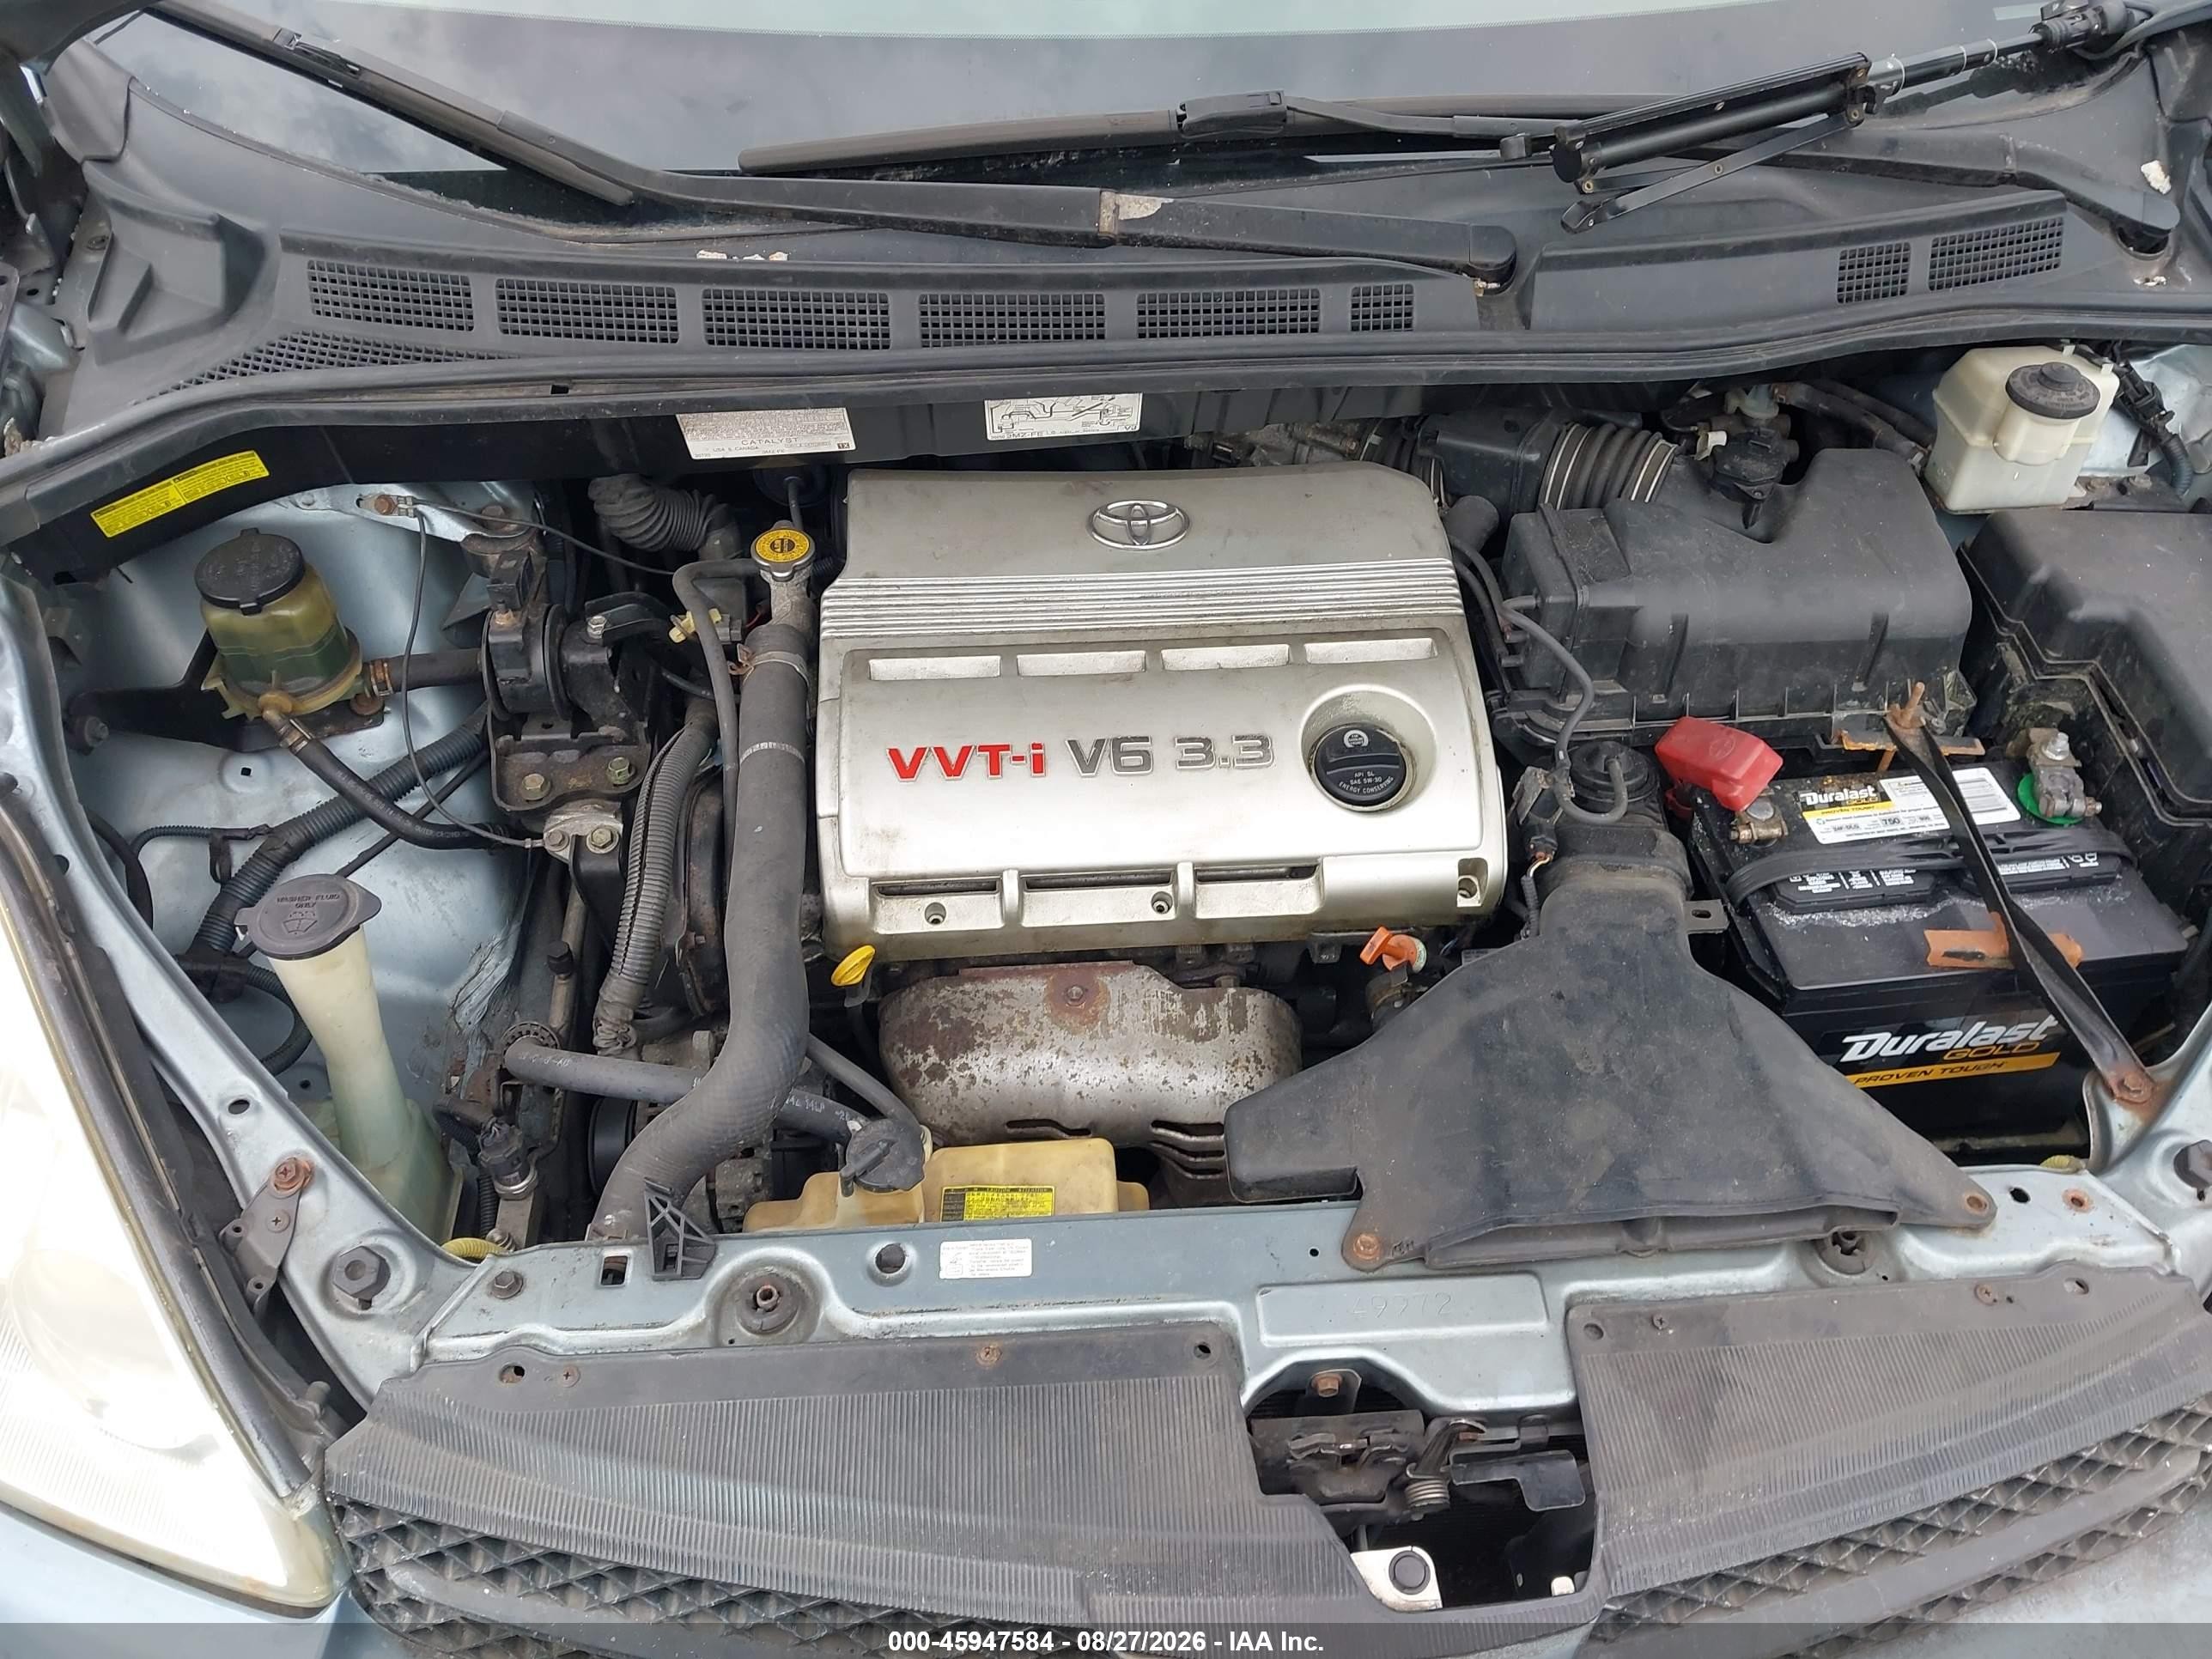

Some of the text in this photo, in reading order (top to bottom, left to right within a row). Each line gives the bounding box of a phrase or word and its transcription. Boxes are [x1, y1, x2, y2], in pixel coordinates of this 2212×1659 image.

[741, 437, 799, 446] CATALYST
[886, 733, 1276, 782] VVT-i V6 3.3
[1340, 775, 1394, 794] ENERGY CONSERVING
[1800, 786, 1876, 805] Duralast
[1881, 817, 1901, 826] 750
[1840, 1014, 2058, 1062] Duralast
[1943, 1042, 2040, 1060] GOLD
[1854, 1062, 2005, 1085] PROVEN TOUGH
